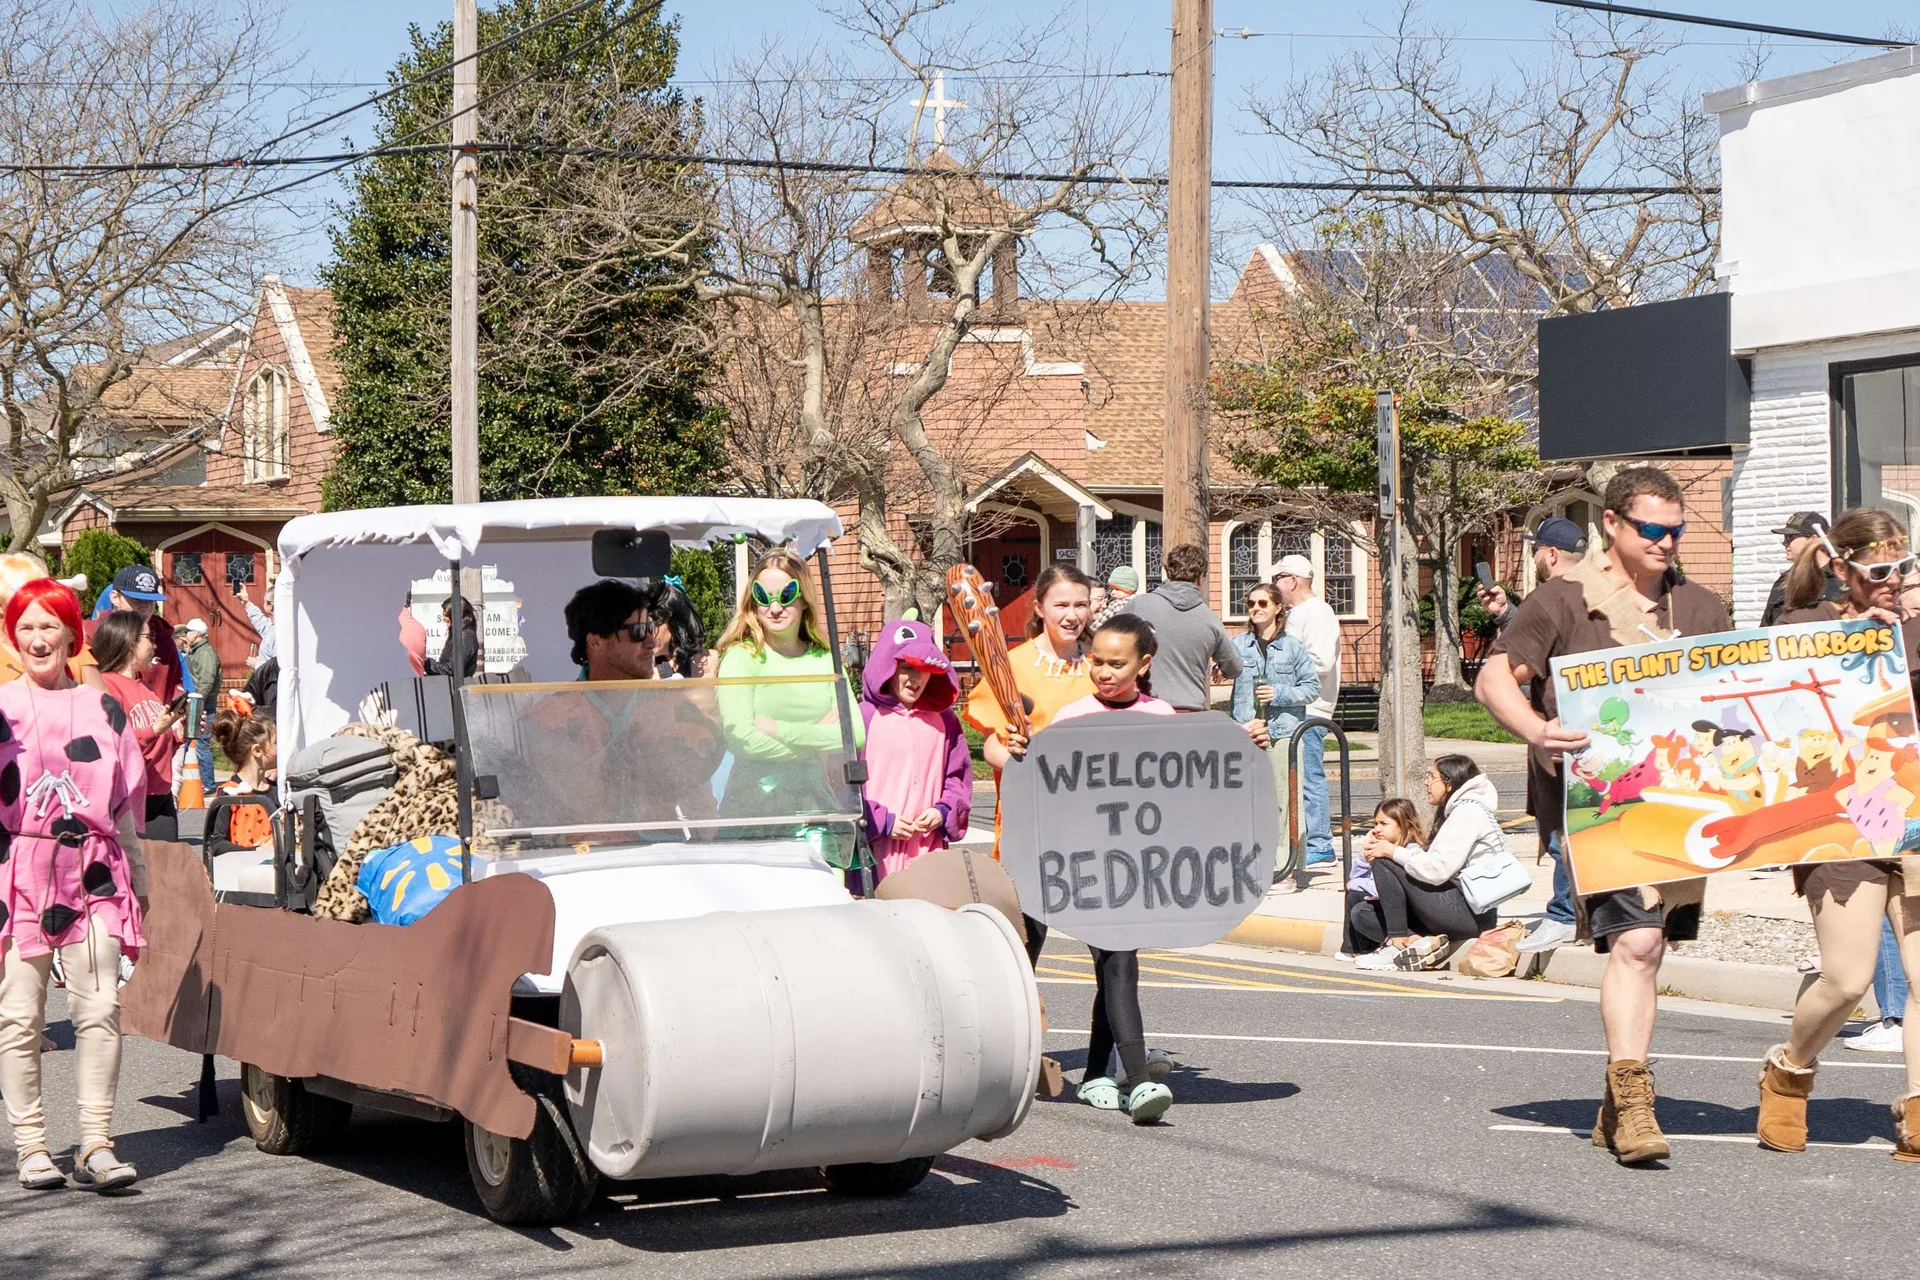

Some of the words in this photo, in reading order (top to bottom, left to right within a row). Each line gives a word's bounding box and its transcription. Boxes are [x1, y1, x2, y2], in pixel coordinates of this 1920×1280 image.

[1379, 405, 1391, 434] ONE
[1379, 440, 1392, 469] WAY
[485, 627, 516, 637] COME!
[486, 613, 501, 623] AM
[1560, 661, 1610, 692] THE
[1611, 650, 1684, 684] FLINT
[1688, 638, 1773, 670] STONE
[1776, 627, 1896, 661] HARBORS
[1036, 749, 1243, 794] WELCOME
[1096, 801, 1162, 836] TO
[1038, 842, 1263, 915] BEDROCK
